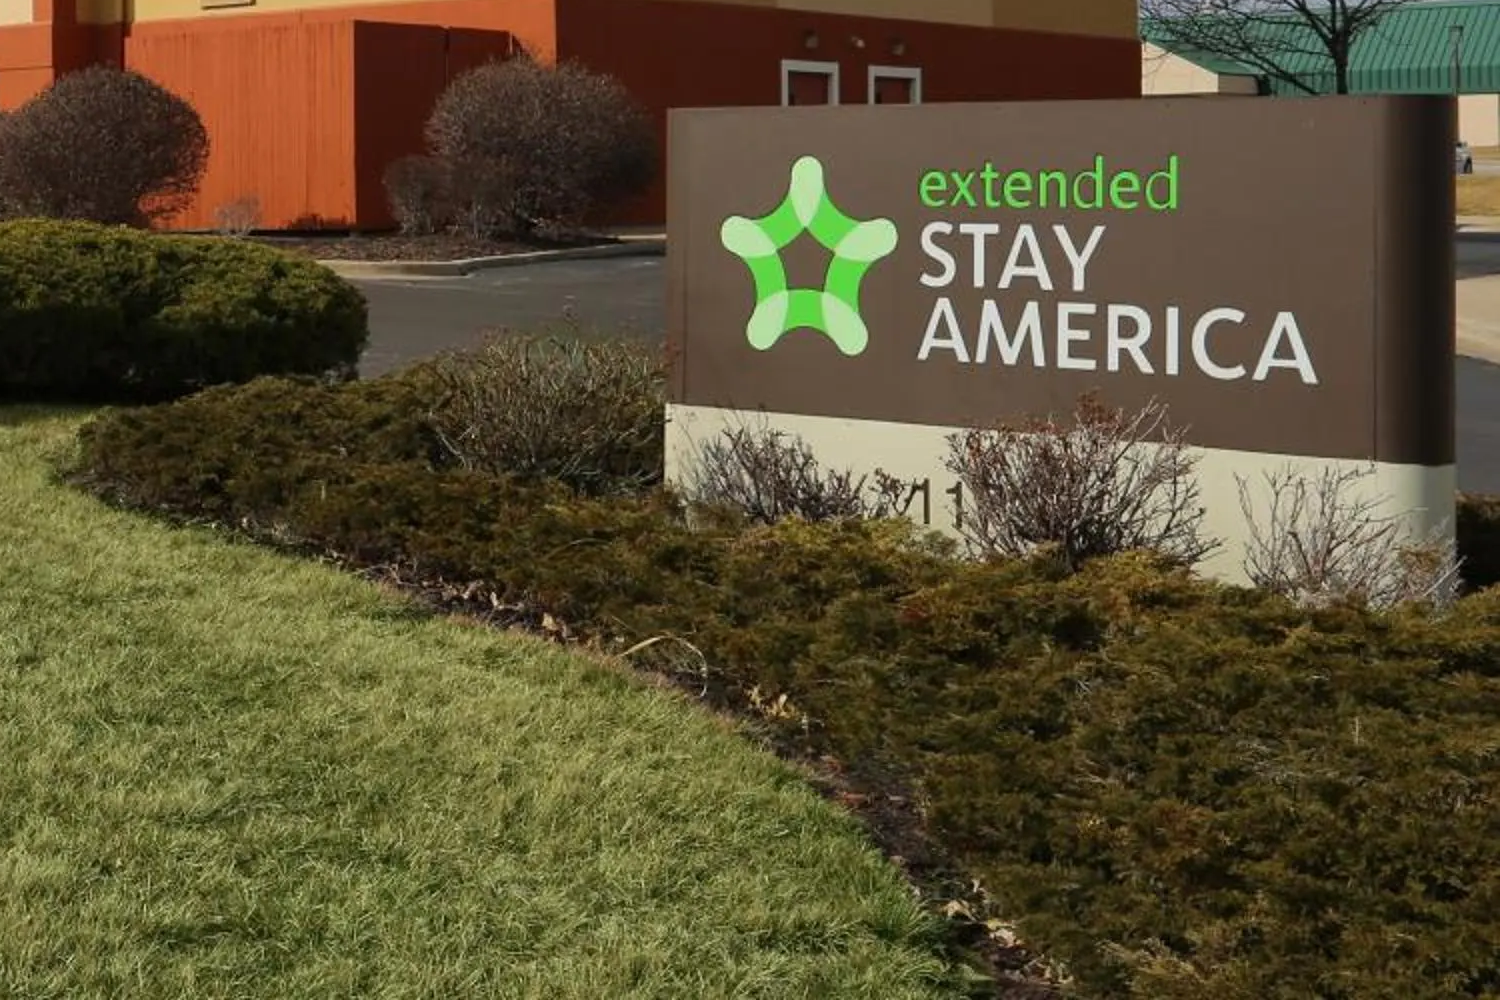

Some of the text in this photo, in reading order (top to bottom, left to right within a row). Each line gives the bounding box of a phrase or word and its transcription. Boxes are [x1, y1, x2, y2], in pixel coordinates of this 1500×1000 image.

[918, 155, 1179, 209] extended
[919, 221, 1107, 291] STAY
[917, 297, 1319, 385] AMERICA
